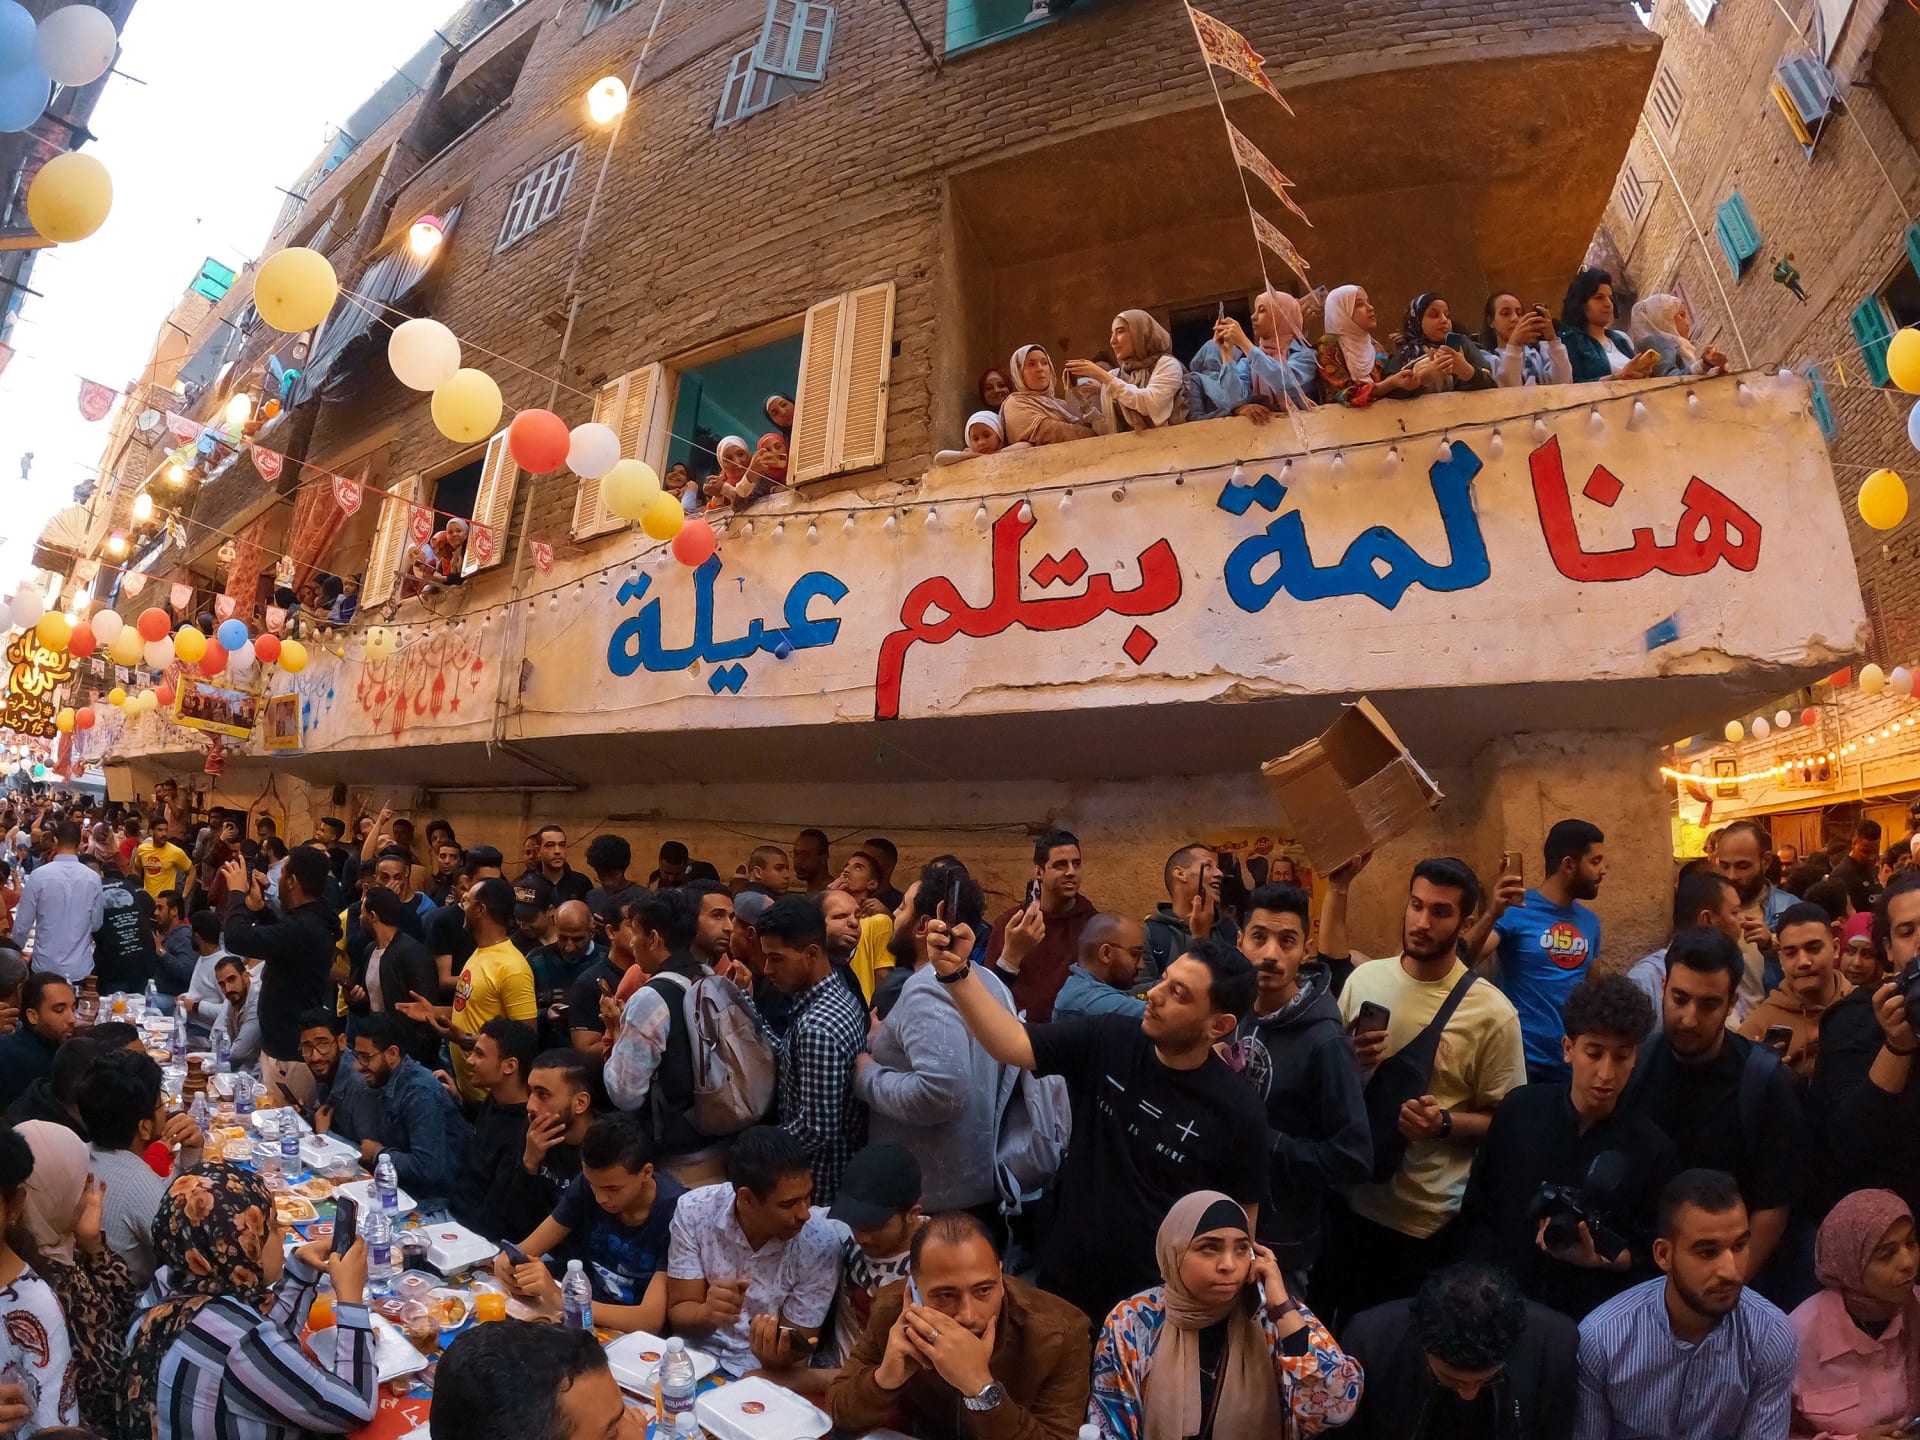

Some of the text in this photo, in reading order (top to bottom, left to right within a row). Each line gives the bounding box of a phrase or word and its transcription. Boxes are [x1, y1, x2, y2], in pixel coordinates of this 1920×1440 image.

[607, 434, 1762, 720] هنا لمة بتلم عيلة
[1155, 1142, 1186, 1163] MORE
